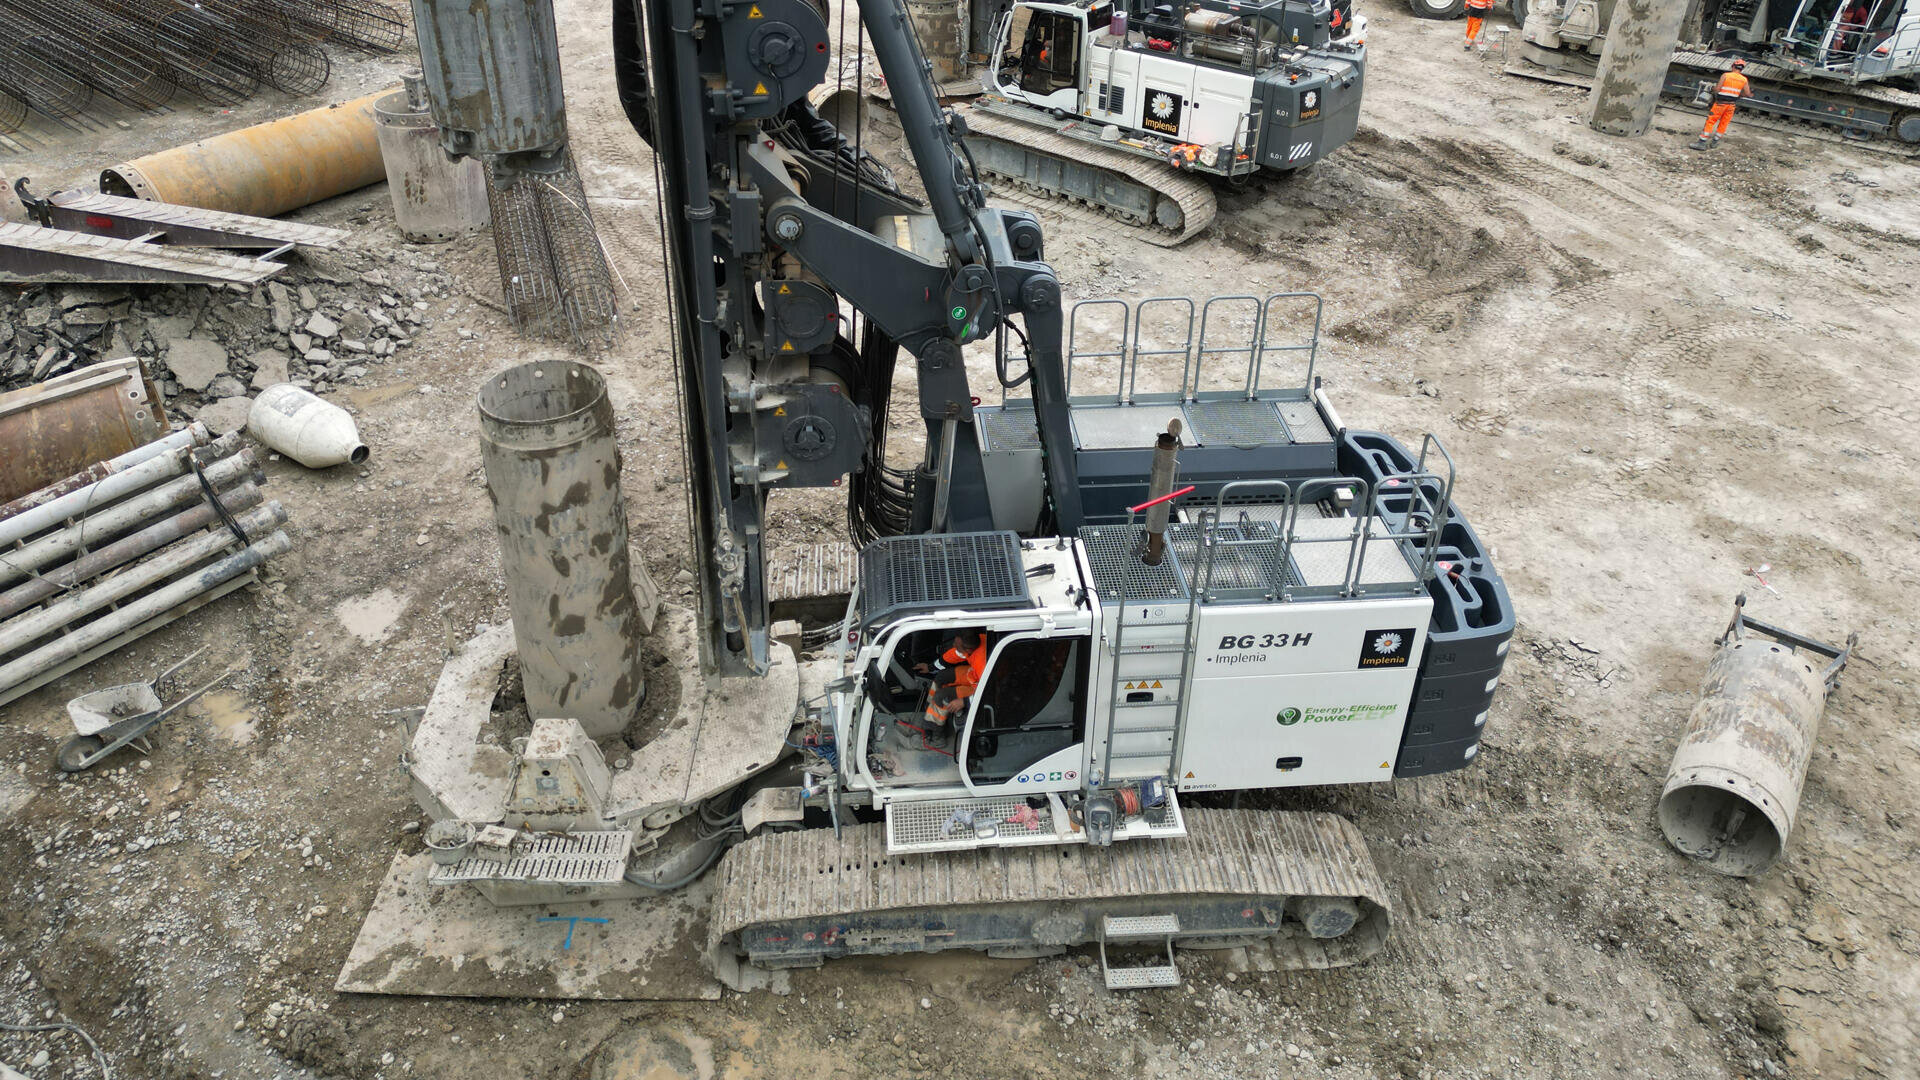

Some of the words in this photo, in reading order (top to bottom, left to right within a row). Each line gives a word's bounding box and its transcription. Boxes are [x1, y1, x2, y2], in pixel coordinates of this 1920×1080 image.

[1145, 117, 1178, 133] Implenia
[1218, 634, 1256, 650] BG
[1258, 633, 1290, 648] 33
[1292, 632, 1313, 647] H
[1215, 652, 1267, 665] Implenia
[1362, 656, 1405, 665] Implenia
[1303, 714, 1354, 724] Power
